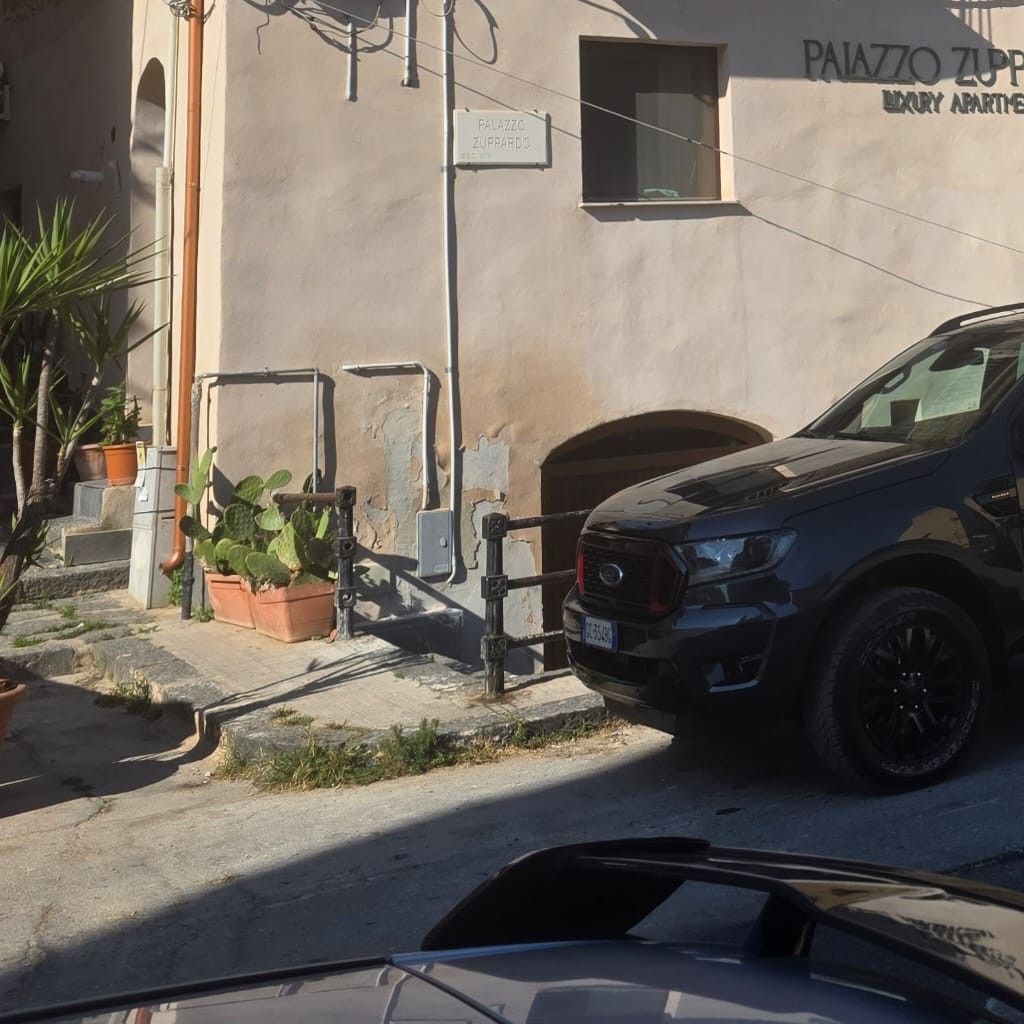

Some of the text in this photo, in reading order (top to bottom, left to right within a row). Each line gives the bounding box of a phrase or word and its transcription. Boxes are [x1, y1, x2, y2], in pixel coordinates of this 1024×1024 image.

[803, 39, 941, 85] PALAZZO
[882, 89, 944, 114] LUXURY
[478, 119, 526, 131] PALAZZO
[472, 136, 531, 149] ZUPPARDO
